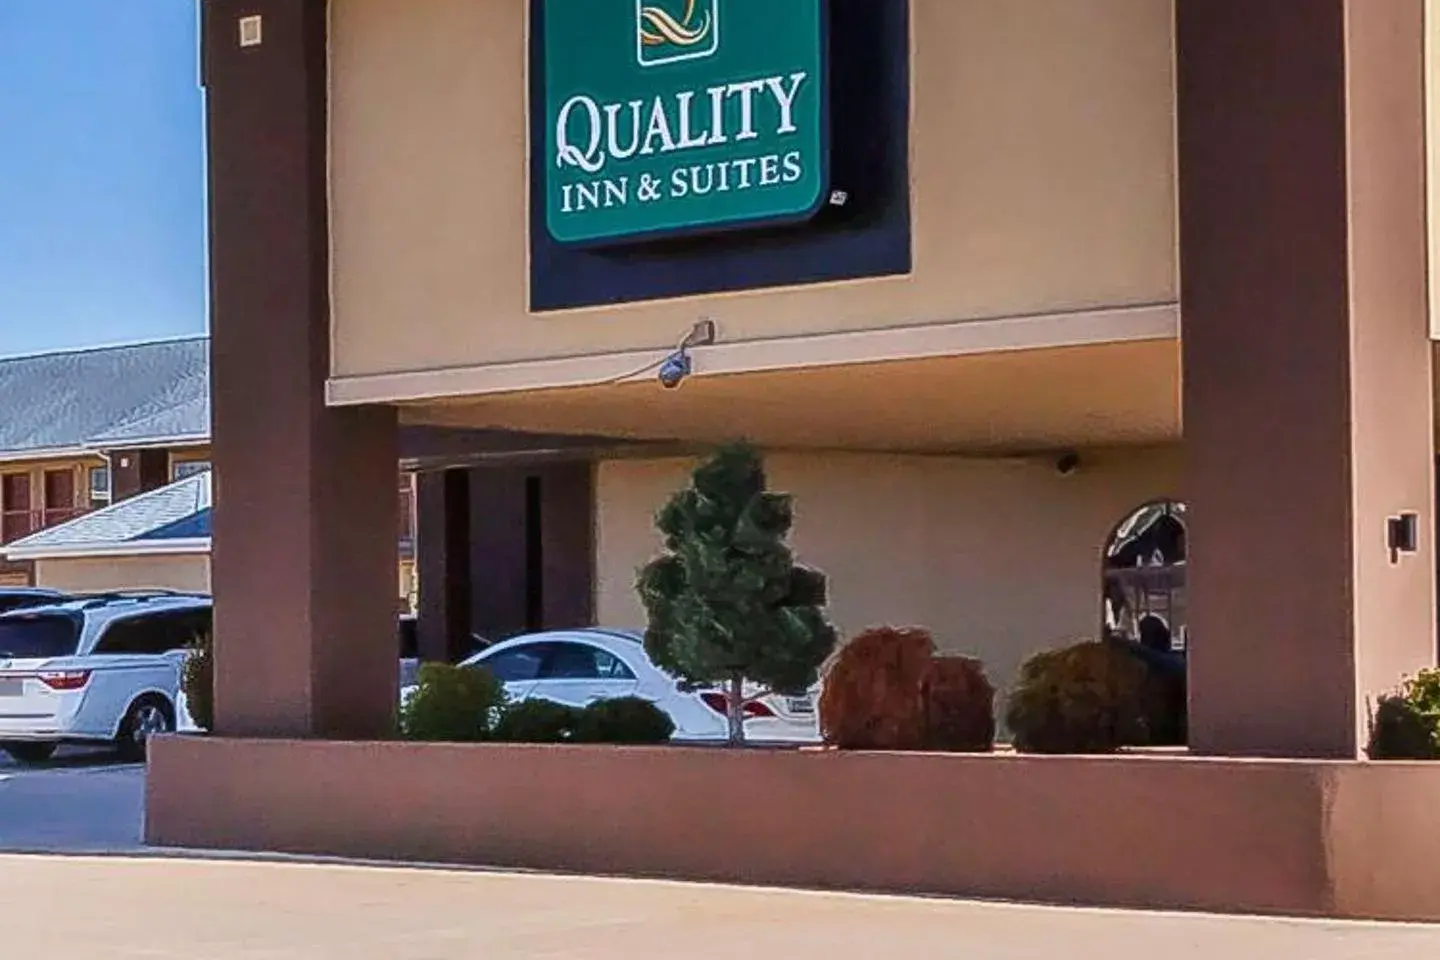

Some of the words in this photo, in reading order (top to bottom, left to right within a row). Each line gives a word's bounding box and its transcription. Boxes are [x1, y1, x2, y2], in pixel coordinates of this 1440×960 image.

[556, 71, 806, 172] QUALITY
[560, 176, 628, 212] INN
[637, 173, 661, 201] &
[671, 151, 801, 197] SUITES
